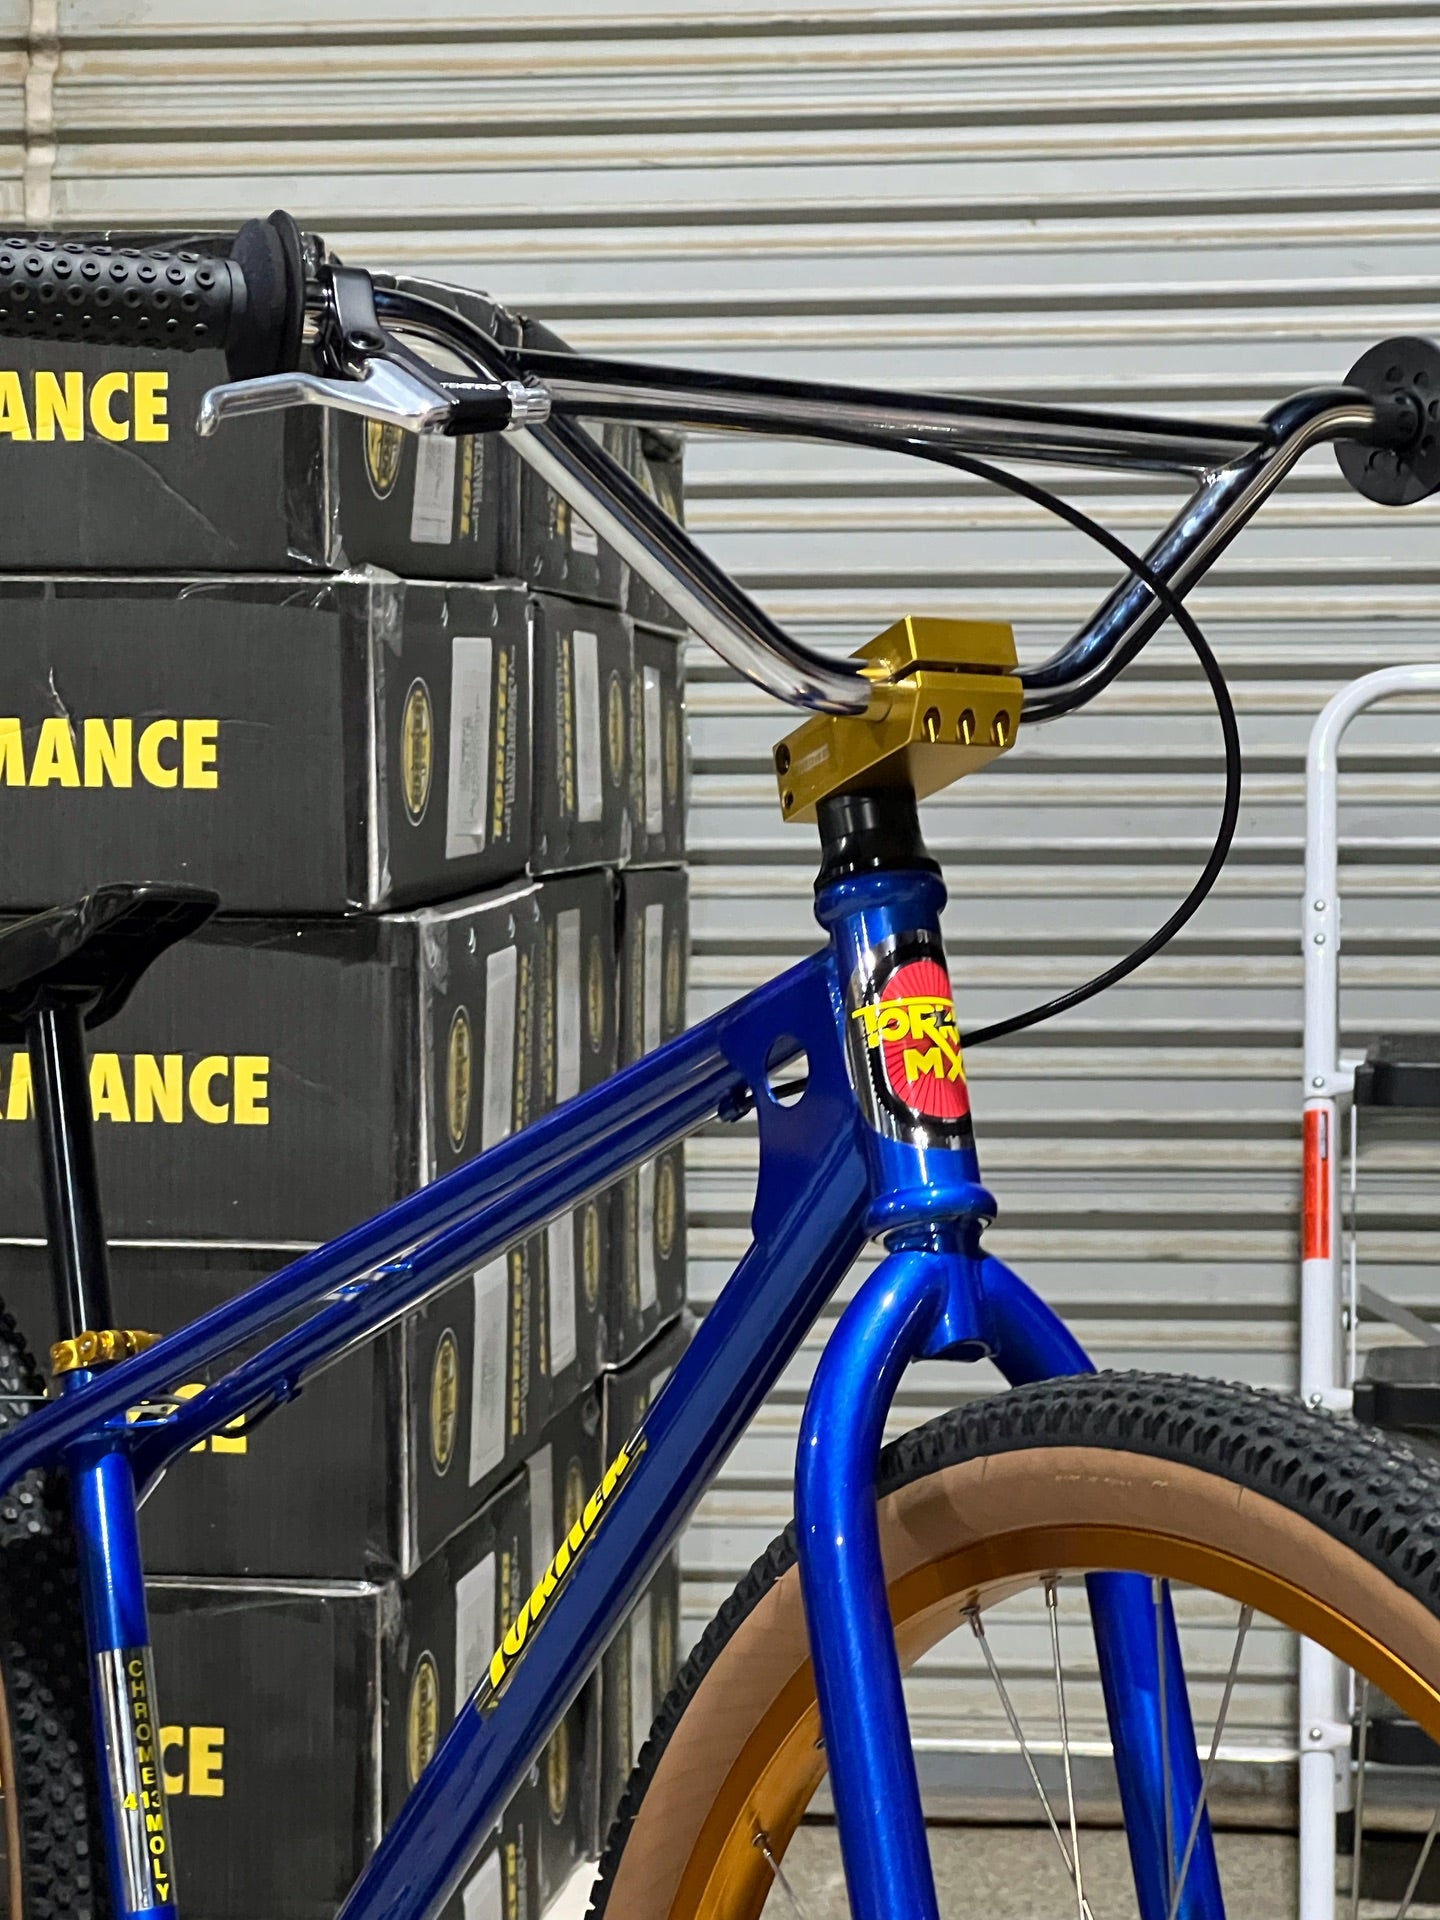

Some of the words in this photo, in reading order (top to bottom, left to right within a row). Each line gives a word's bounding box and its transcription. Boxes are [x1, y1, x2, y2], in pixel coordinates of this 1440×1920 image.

[440, 382, 502, 391] TEKTRO
[0, 1053, 270, 1125] ANCE
[903, 1047, 966, 1083] MX
[128, 1659, 156, 1785] CHROME
[146, 1814, 169, 1902] MOLY
